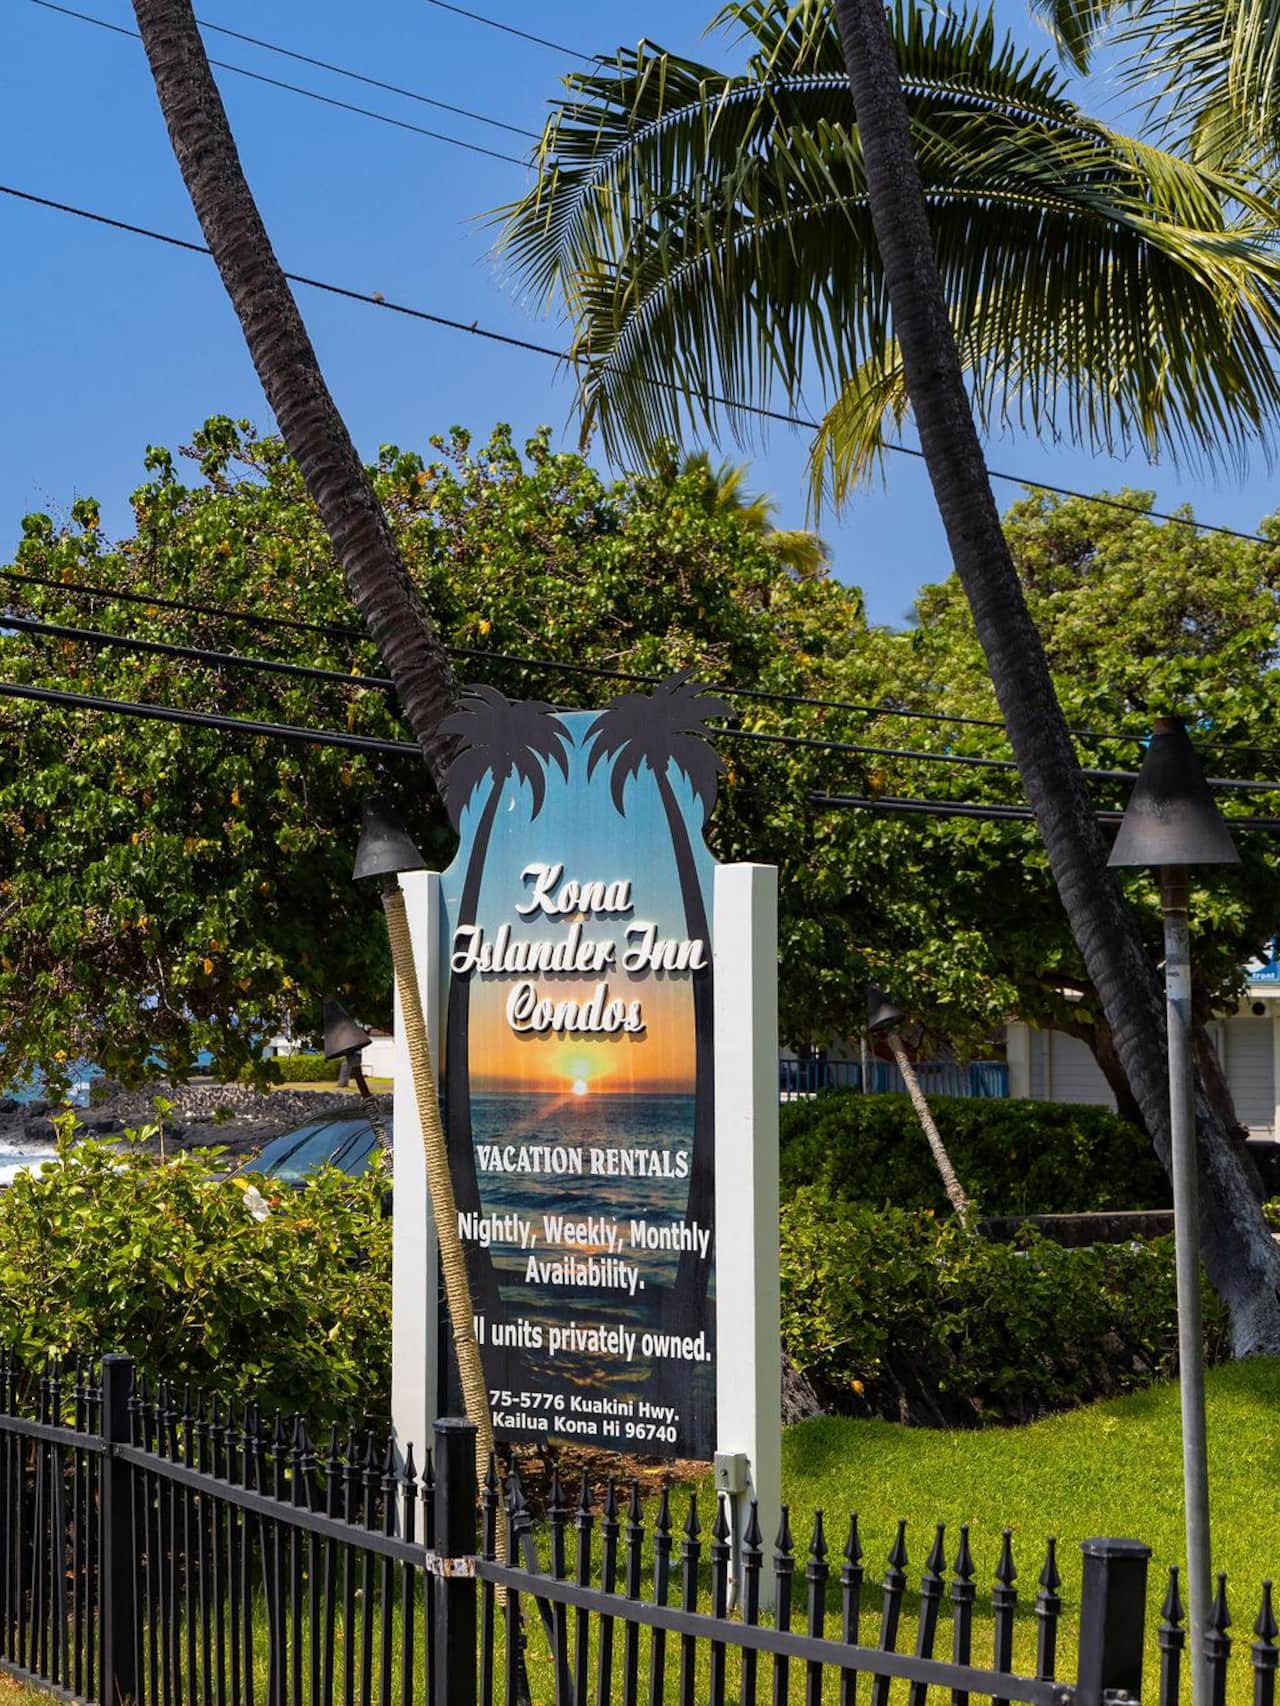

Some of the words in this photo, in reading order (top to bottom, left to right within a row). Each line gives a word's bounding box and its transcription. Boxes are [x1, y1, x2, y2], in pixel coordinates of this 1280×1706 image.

[515, 863, 634, 915] Kona
[450, 924, 616, 973] Islander
[622, 921, 709, 972] Inn
[506, 980, 647, 1033] Condos
[476, 1144, 583, 1175] VACATION
[589, 1148, 689, 1178] RENTALS
[457, 1211, 537, 1249] Nightly,
[543, 1215, 623, 1253] Weekly,
[630, 1219, 711, 1259] Monthly
[525, 1255, 645, 1296] Availability.
[473, 1316, 485, 1345] ll
[491, 1318, 543, 1349] units
[549, 1321, 636, 1362] privately
[641, 1331, 711, 1362] owned.
[489, 1390, 565, 1410] 75-5776
[570, 1395, 634, 1416] Kuakini
[638, 1401, 680, 1424] Hwy.
[493, 1411, 548, 1431] Kailua
[554, 1416, 597, 1435] Kona
[602, 1420, 620, 1437] Hi
[625, 1425, 677, 1442] 96740
